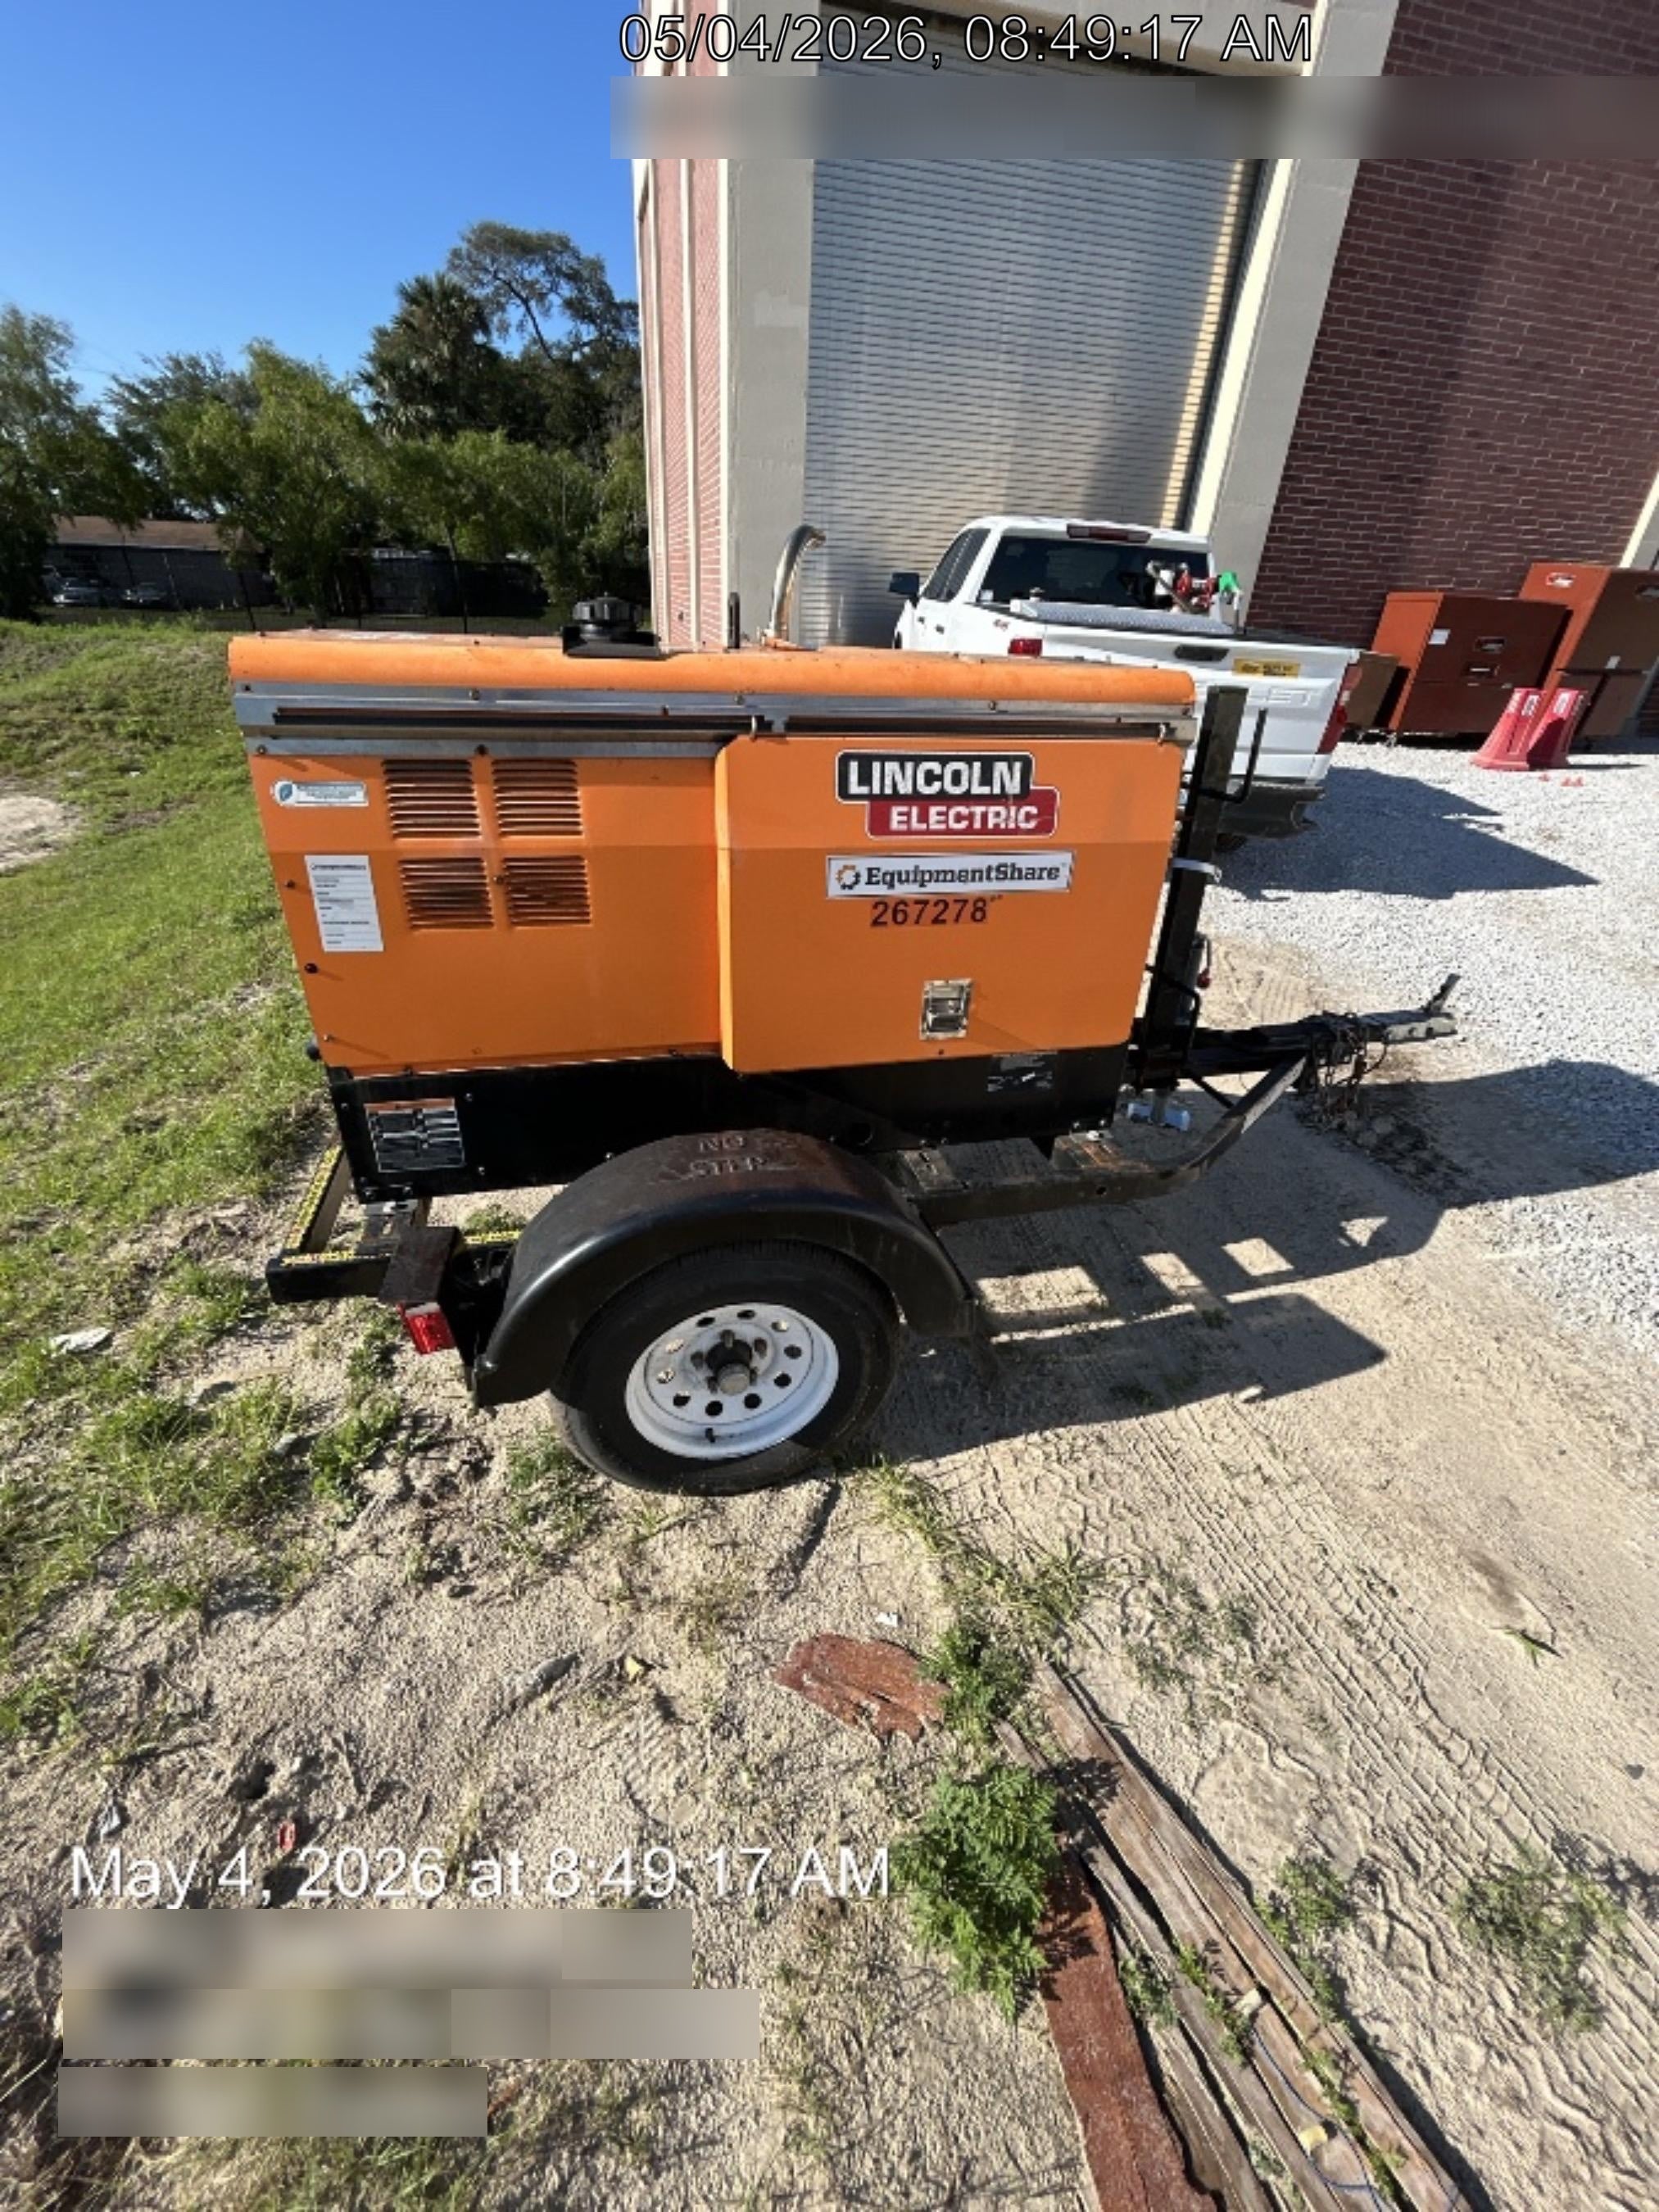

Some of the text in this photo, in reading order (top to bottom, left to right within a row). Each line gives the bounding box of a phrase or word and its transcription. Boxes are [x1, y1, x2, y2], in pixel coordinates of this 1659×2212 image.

[846, 760, 1023, 796] LINCOLN
[889, 805, 1039, 832] ELECTRIC
[864, 862, 1060, 891] EquipmentShare
[869, 898, 987, 927] 267278
